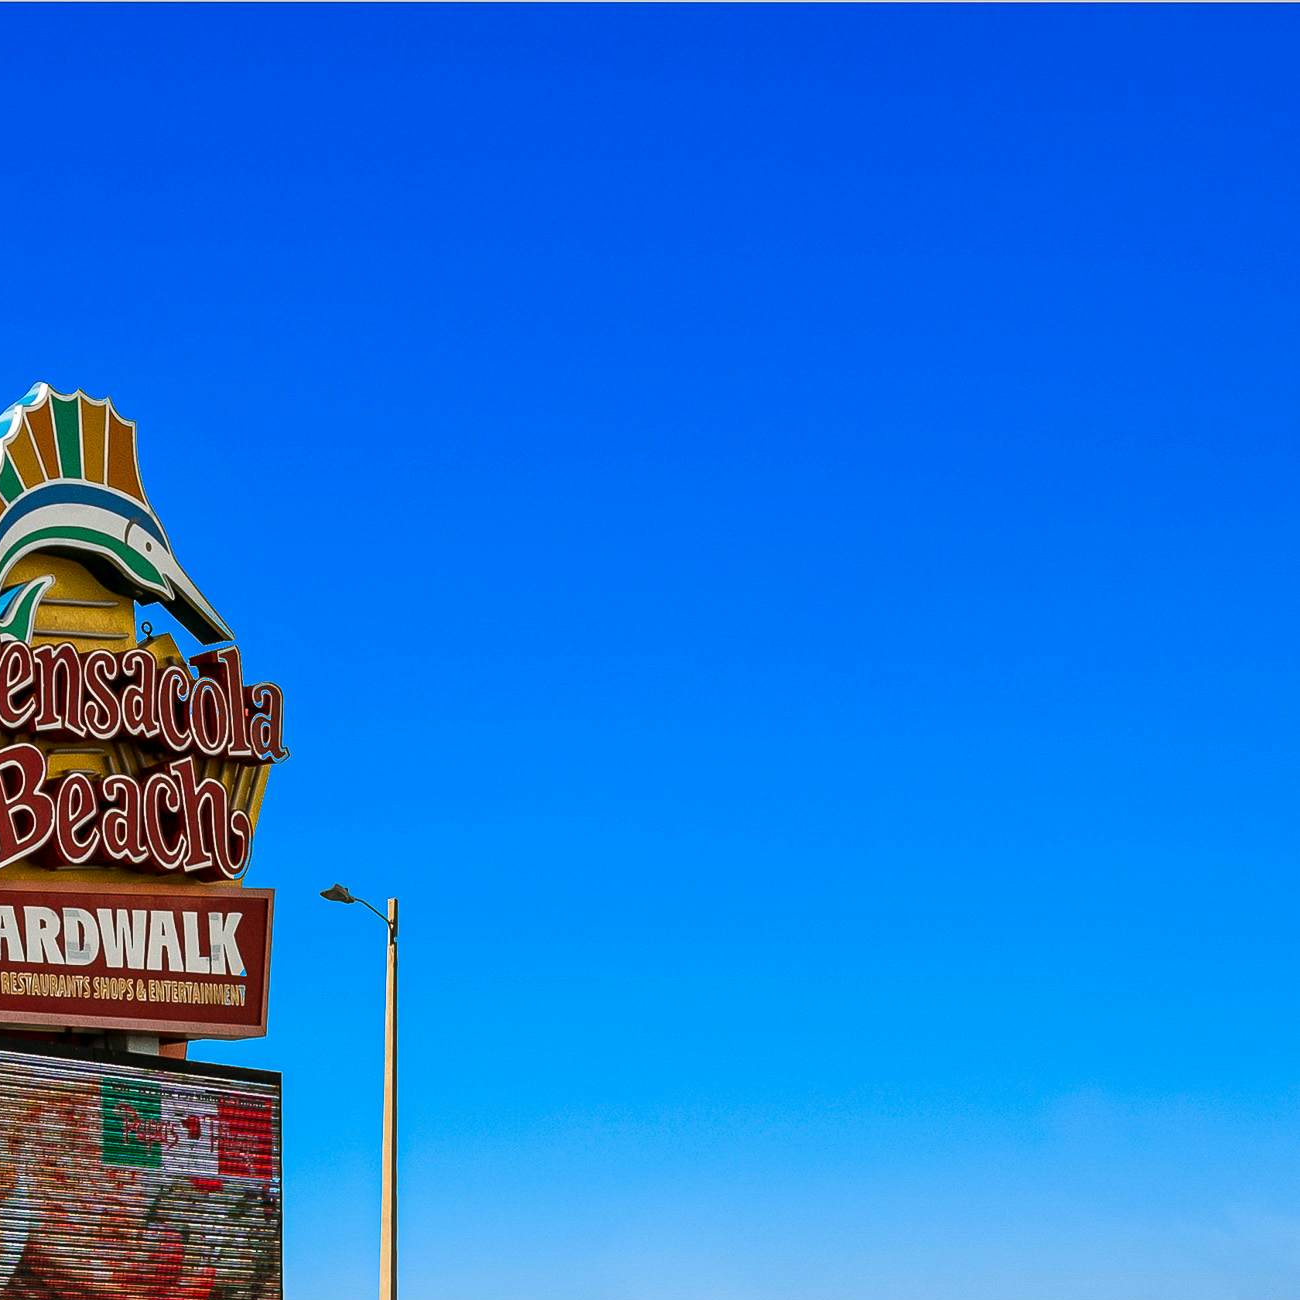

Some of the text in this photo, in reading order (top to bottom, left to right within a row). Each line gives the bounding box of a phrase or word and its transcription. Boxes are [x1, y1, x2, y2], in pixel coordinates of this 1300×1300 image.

[1, 971, 91, 999] RESTAURANTS
[93, 976, 134, 1001] SHOPS
[136, 979, 147, 1002] &
[148, 979, 246, 1007] ENTERTAINMENT
